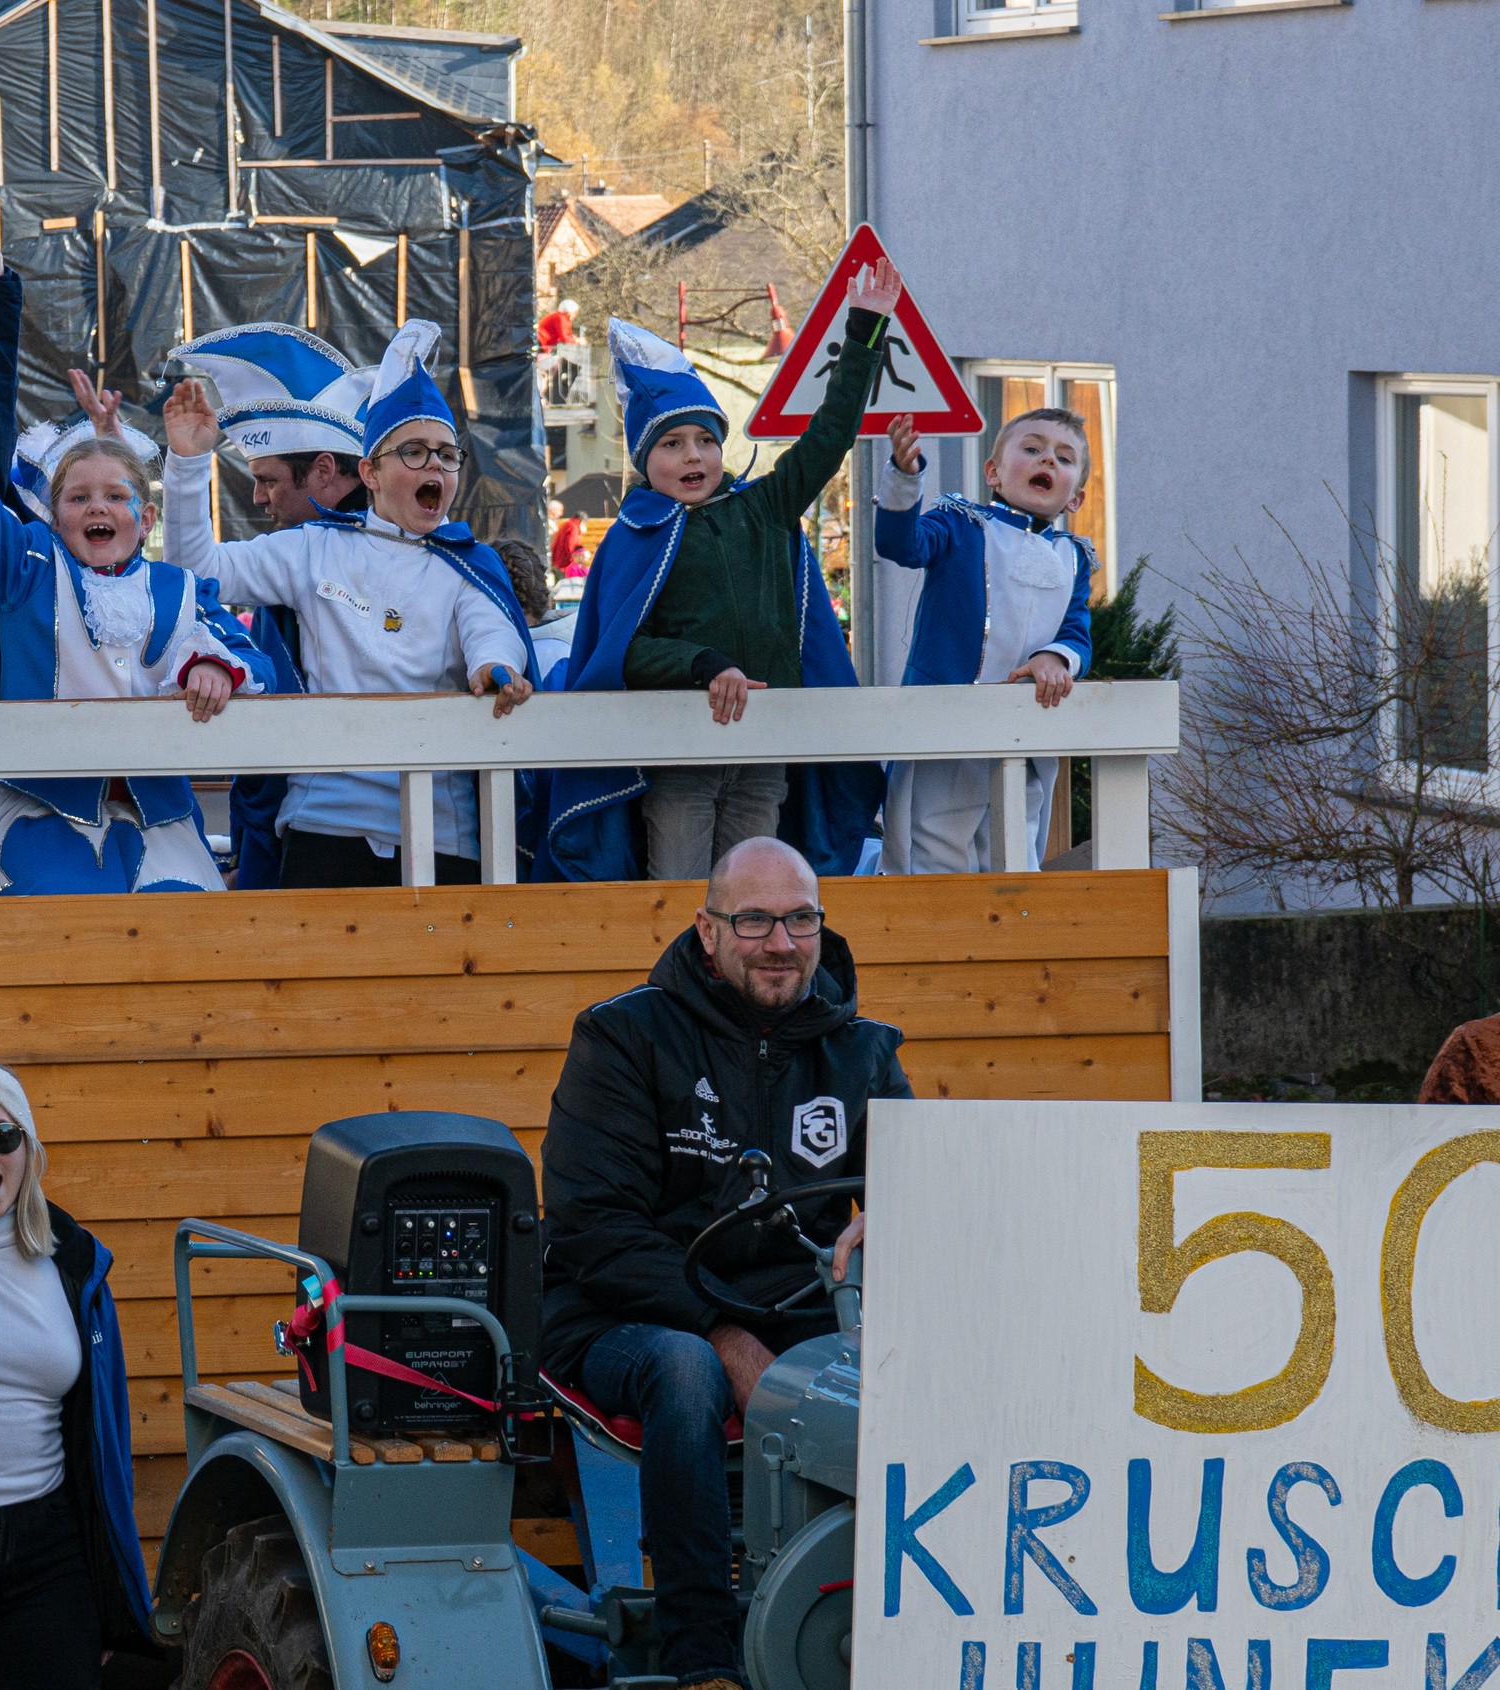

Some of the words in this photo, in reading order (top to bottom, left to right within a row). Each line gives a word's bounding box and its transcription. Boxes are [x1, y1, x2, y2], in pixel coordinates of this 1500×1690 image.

[241, 431, 271, 449] KKV
[405, 1350, 474, 1359] EUROPORT
[414, 1401, 461, 1411] behringer
[884, 1457, 1500, 1618] KRUSC
